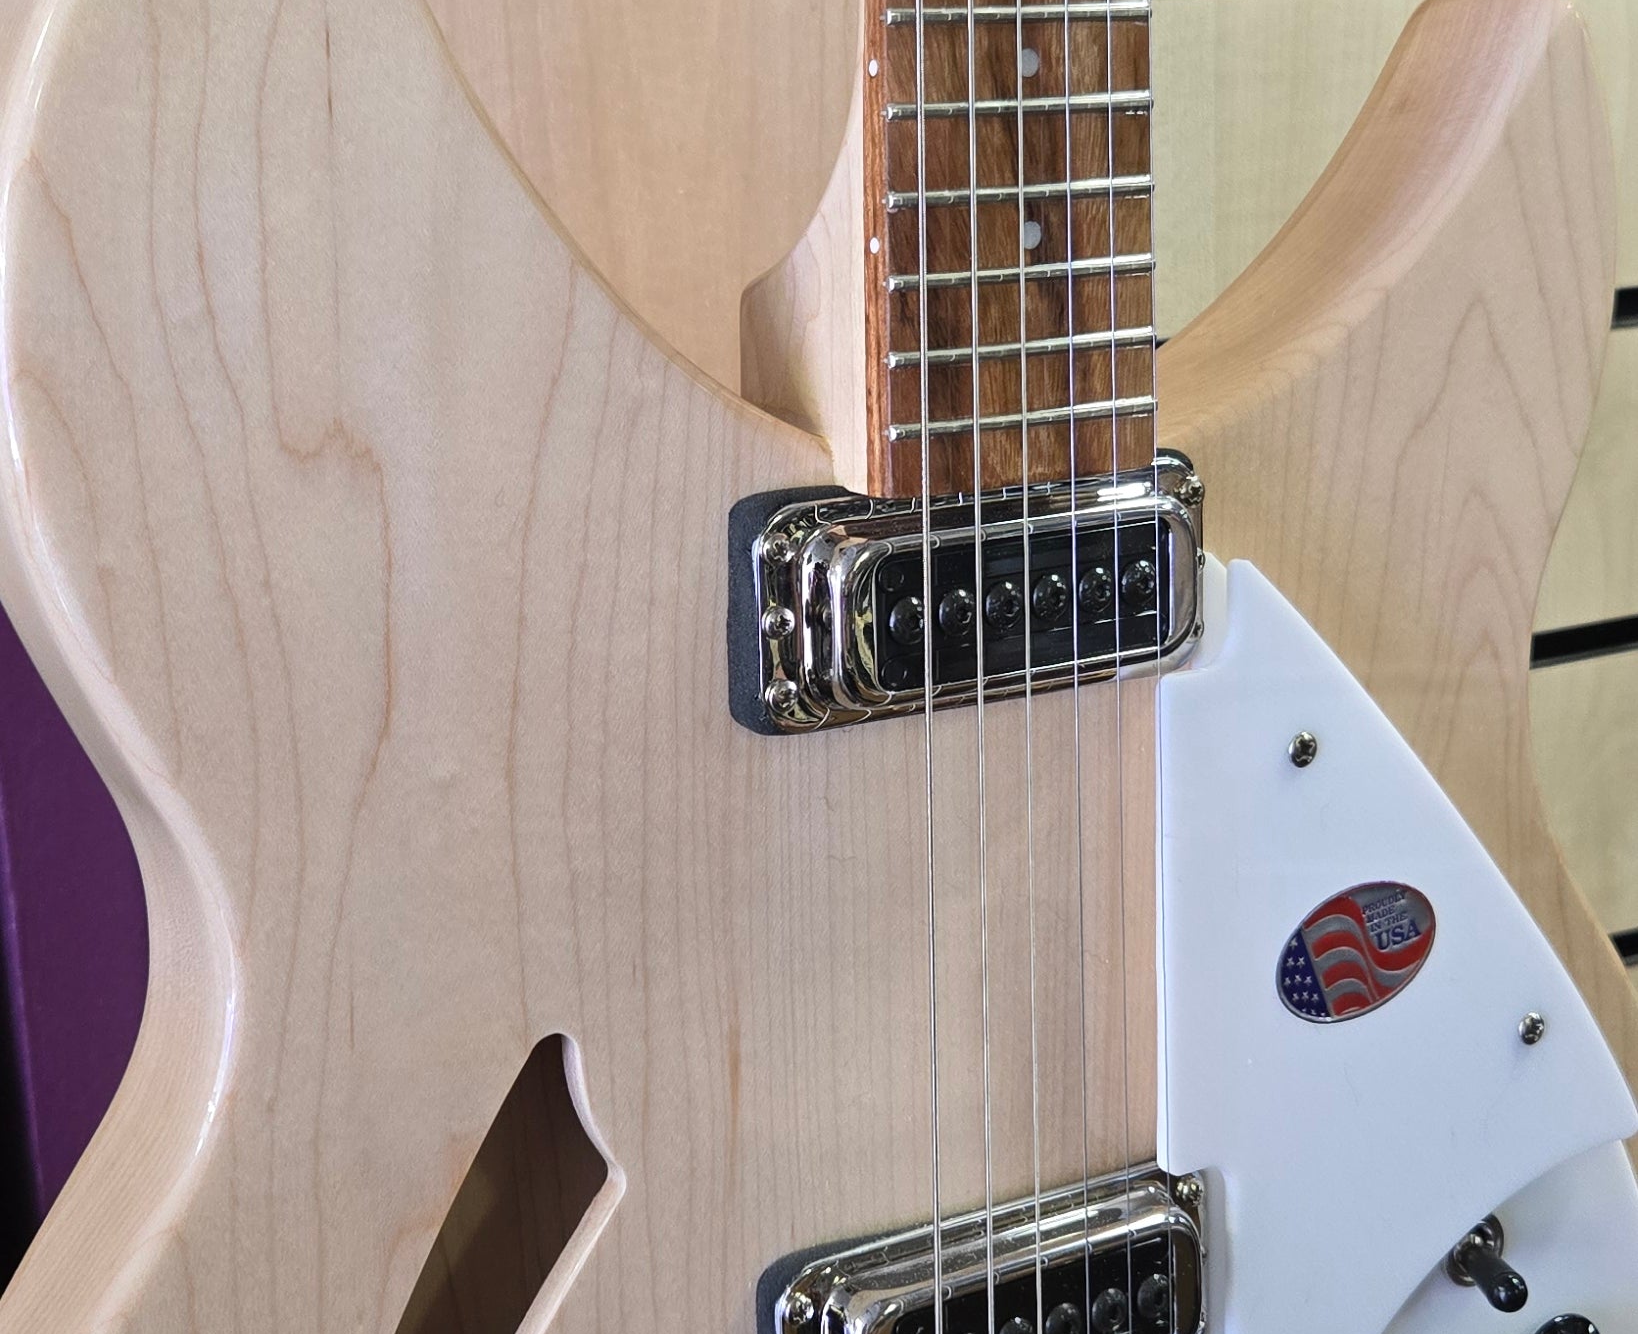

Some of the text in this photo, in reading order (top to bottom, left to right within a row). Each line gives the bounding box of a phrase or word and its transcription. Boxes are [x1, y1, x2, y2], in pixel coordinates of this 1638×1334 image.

[1362, 889, 1407, 914] PROUDLY
[1366, 905, 1396, 923] MADE
[1370, 910, 1408, 932] IN THE
[1375, 919, 1421, 950] USA
